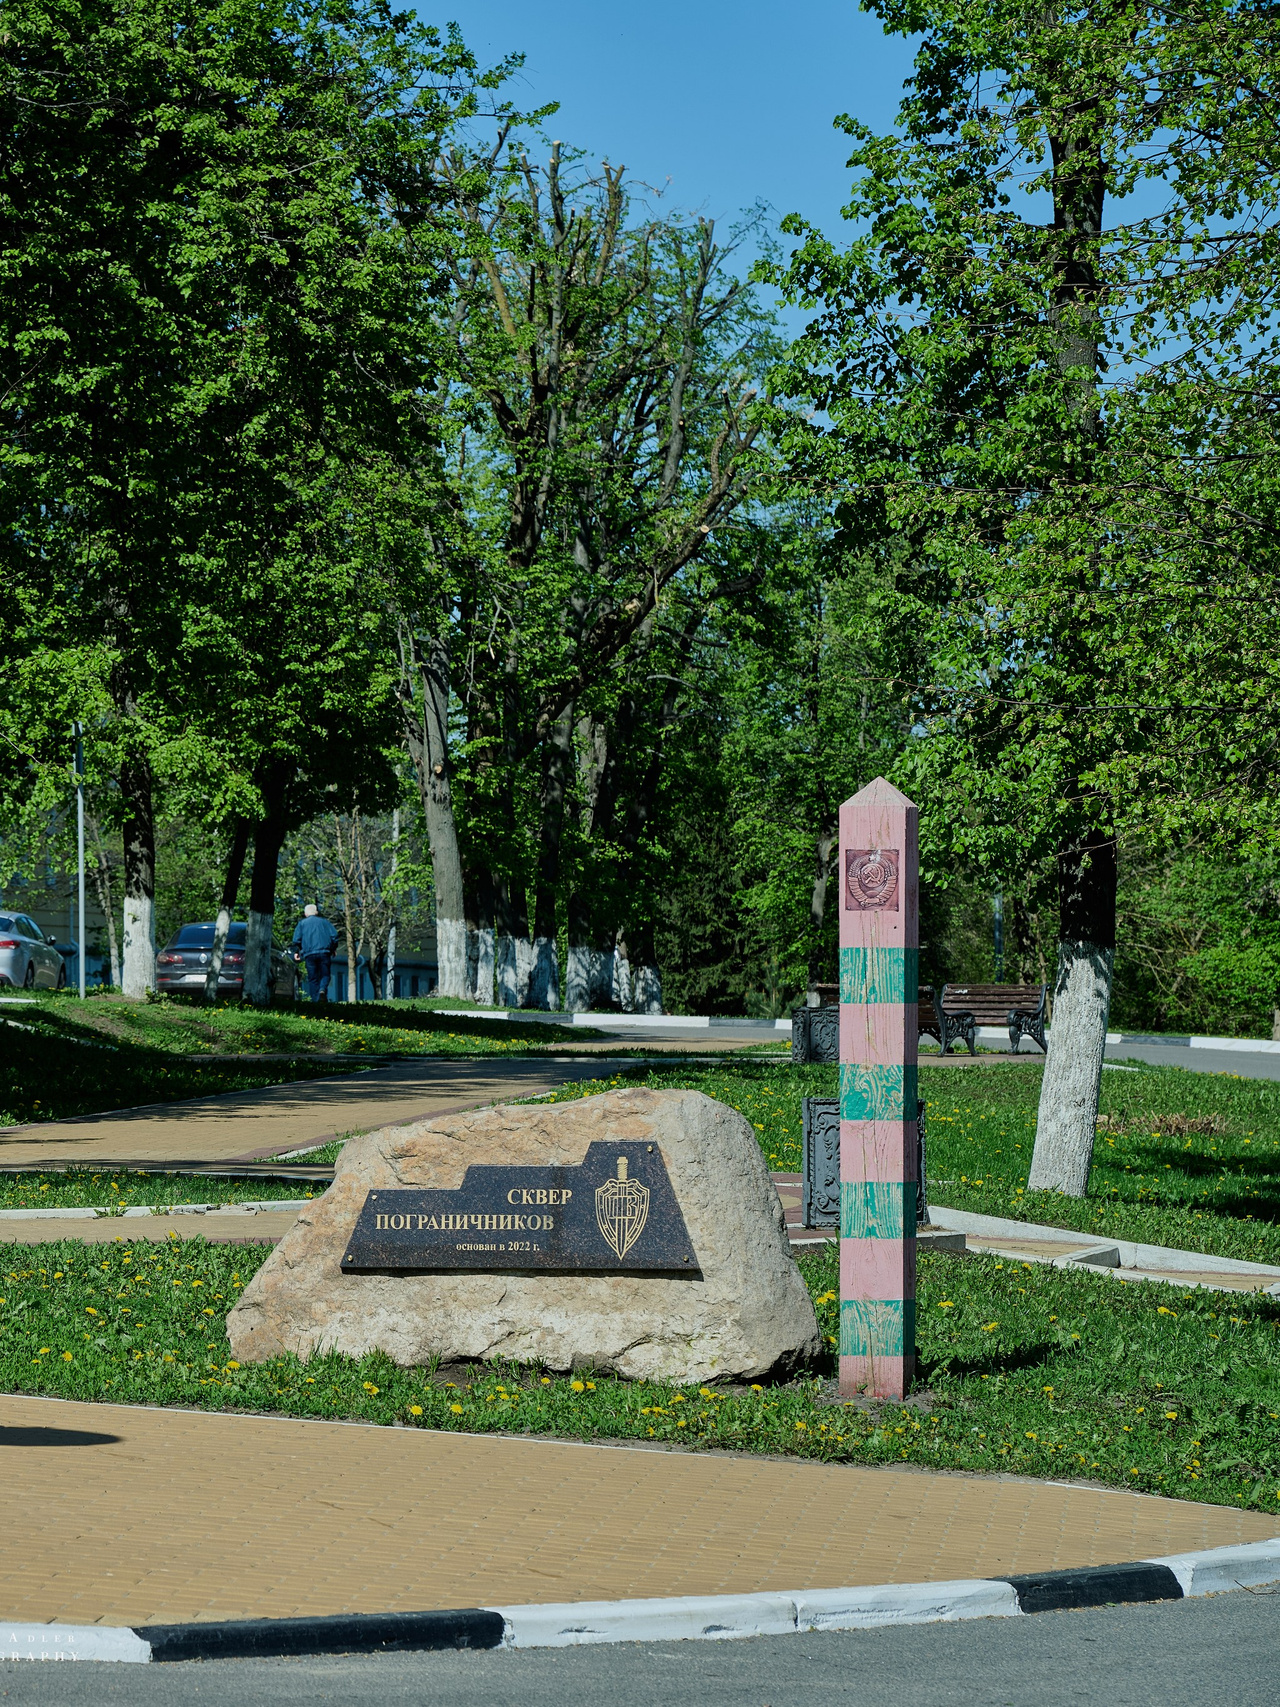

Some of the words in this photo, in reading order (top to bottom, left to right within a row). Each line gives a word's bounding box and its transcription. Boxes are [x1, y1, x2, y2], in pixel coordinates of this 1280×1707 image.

[507, 1188, 573, 1205] СКВЕР
[375, 1214, 555, 1231] ПОГРАНИЧНИКОВ
[456, 1243, 496, 1251] основан
[499, 1243, 505, 1251] в
[508, 1241, 531, 1251] 2022
[533, 1243, 540, 1251] г.
